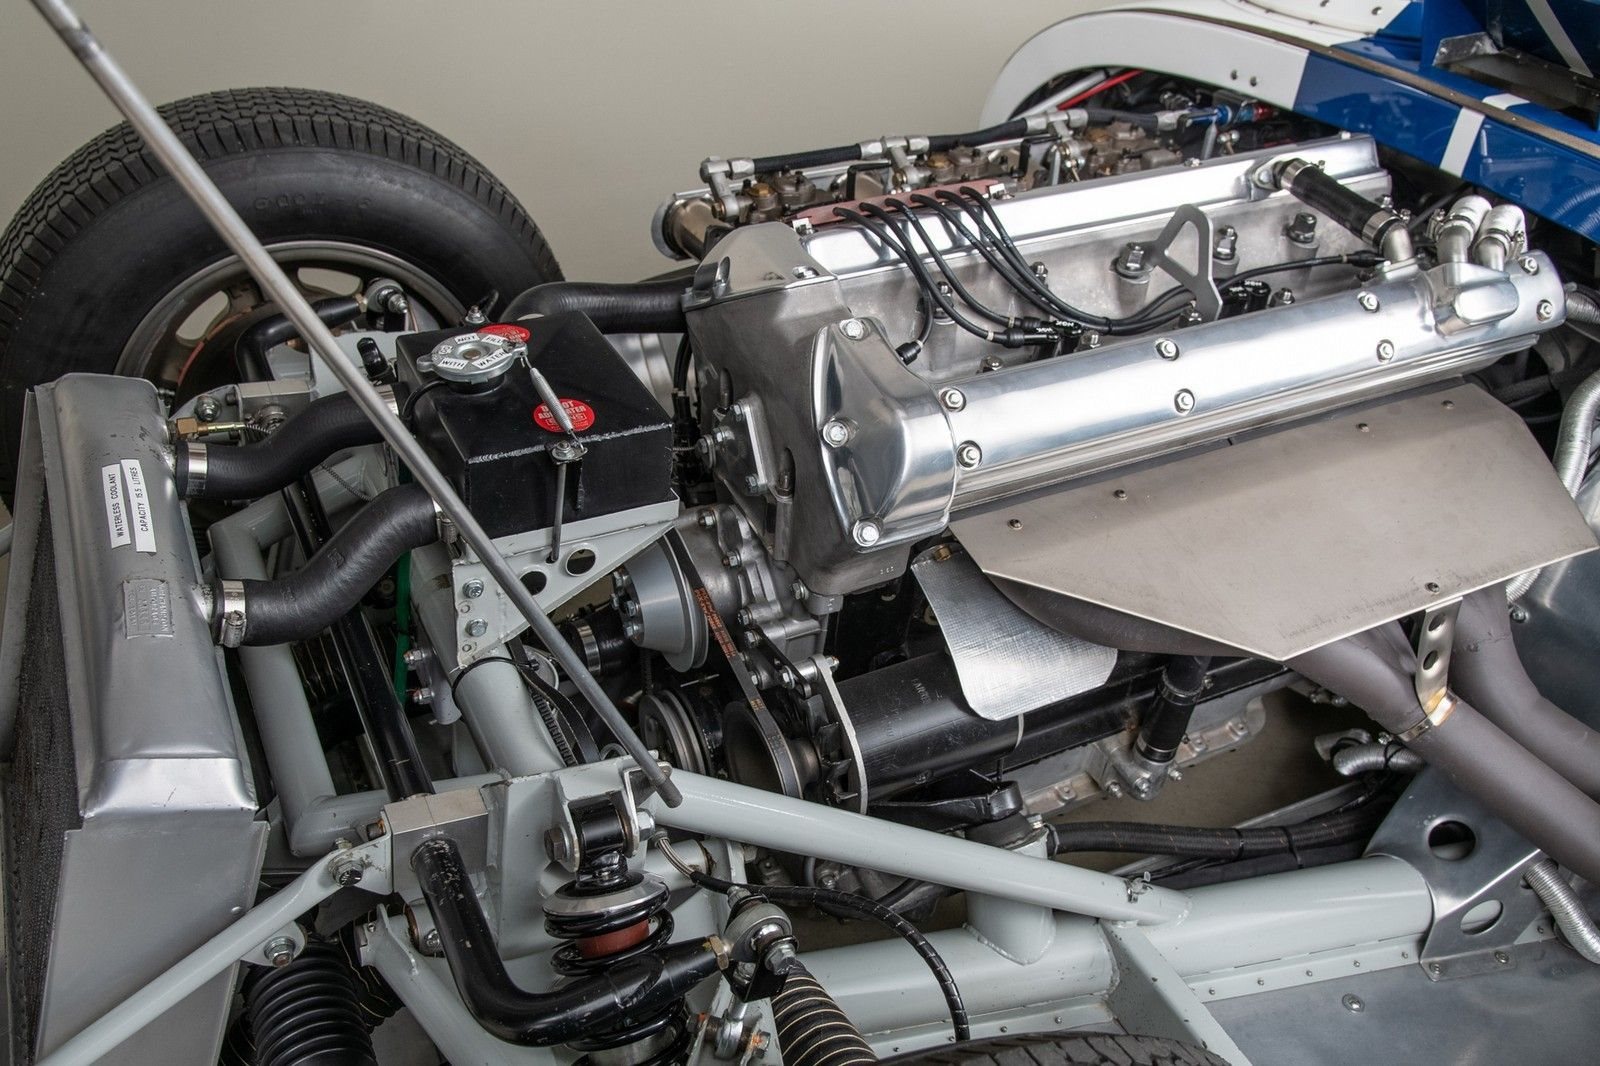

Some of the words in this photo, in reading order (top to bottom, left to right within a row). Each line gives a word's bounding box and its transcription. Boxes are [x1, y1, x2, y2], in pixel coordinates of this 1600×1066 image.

[478, 351, 506, 366] WATER
[108, 473, 119, 499] COOLANT
[129, 466, 140, 485] LITRES
[112, 502, 124, 537] WATERLESS
[137, 502, 149, 532] CAPACITY
